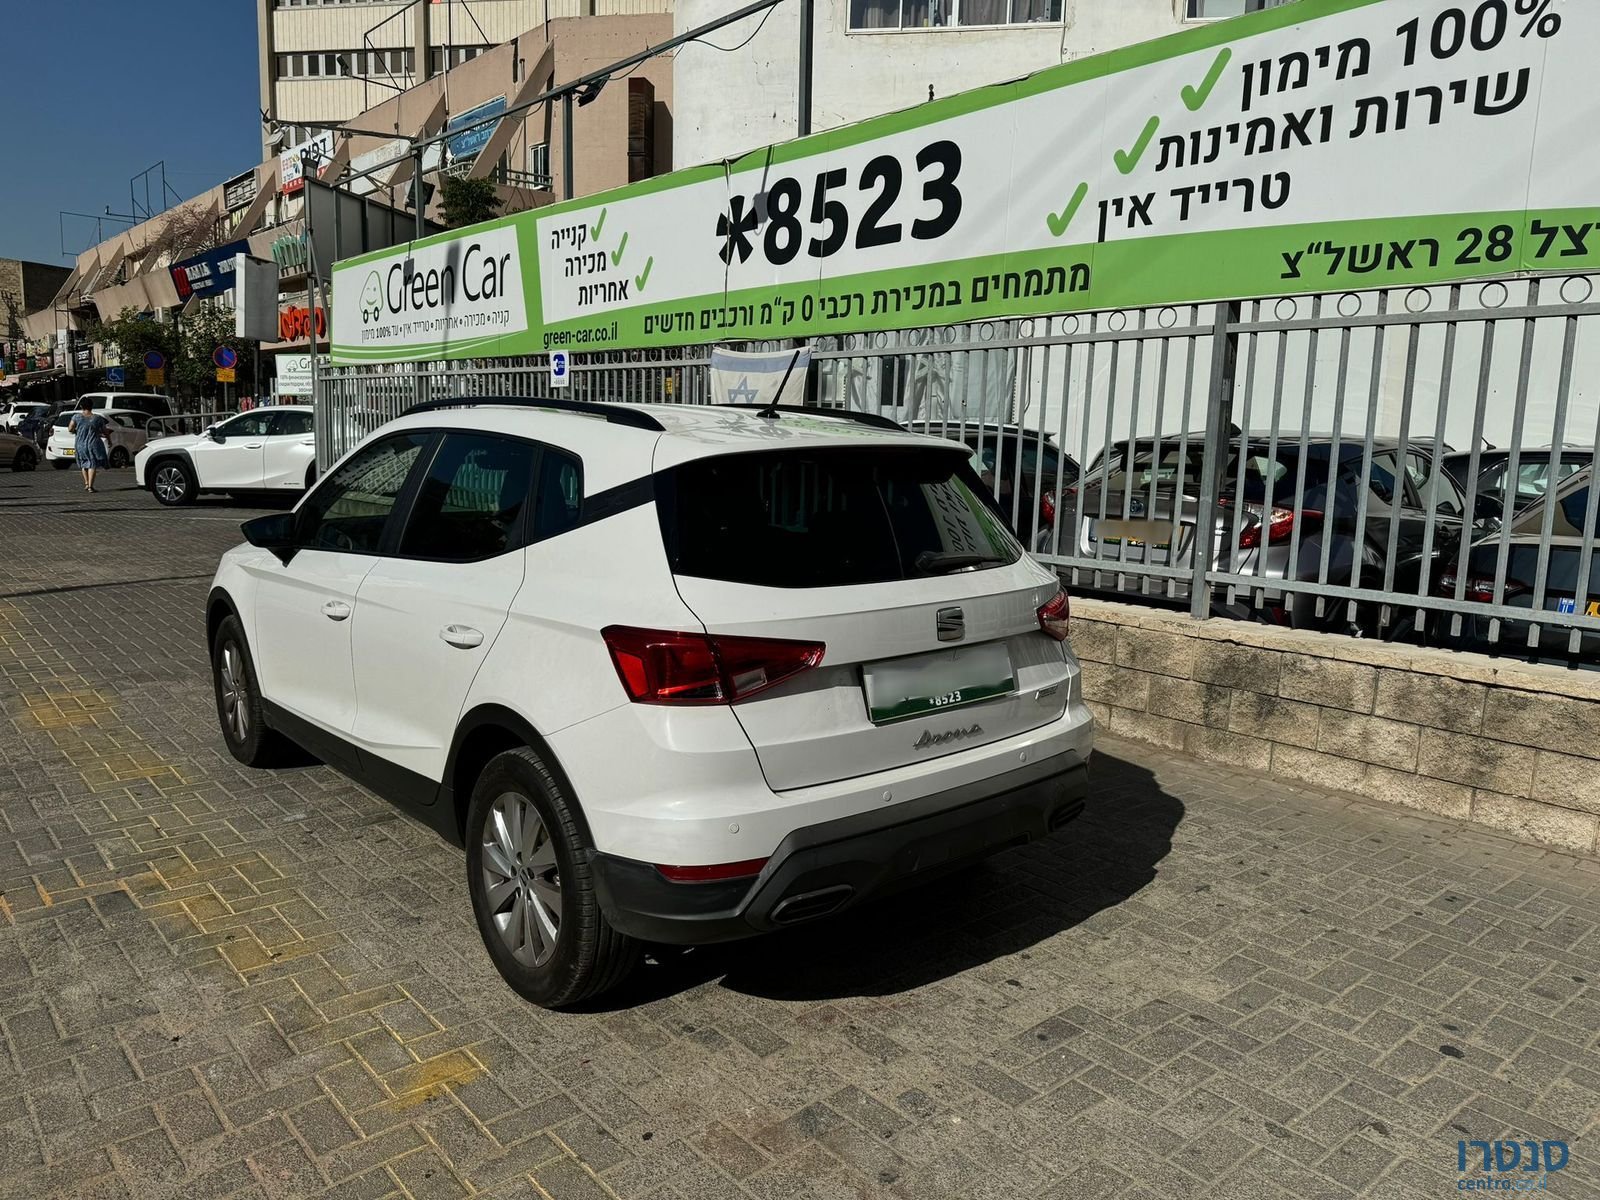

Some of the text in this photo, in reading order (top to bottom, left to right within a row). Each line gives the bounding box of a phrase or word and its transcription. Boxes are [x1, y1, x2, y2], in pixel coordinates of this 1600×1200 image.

[1240, 0, 1561, 110] 100% מימון
[1155, 68, 1530, 171] שירות ואמינות
[1098, 171, 1291, 242] טרייד אין
[552, 223, 586, 250] קנייה
[1454, 225, 1514, 264] 28
[565, 251, 606, 277] מכירה
[387, 243, 510, 314] Green Car
[971, 262, 1091, 301] מתמחים
[578, 279, 629, 306] אחריות
[818, 292, 864, 320] רכבי
[871, 279, 962, 315] במכירת
[464, 312, 485, 327] מכירה
[492, 310, 509, 327] קניה
[700, 304, 753, 330] ורכבים
[802, 295, 813, 321] 0
[376, 325, 391, 339] 100%
[413, 319, 429, 333] טרייד
[435, 316, 459, 331] אחריות
[543, 321, 618, 349] green-car.co.il
[644, 311, 694, 334] חדשים
